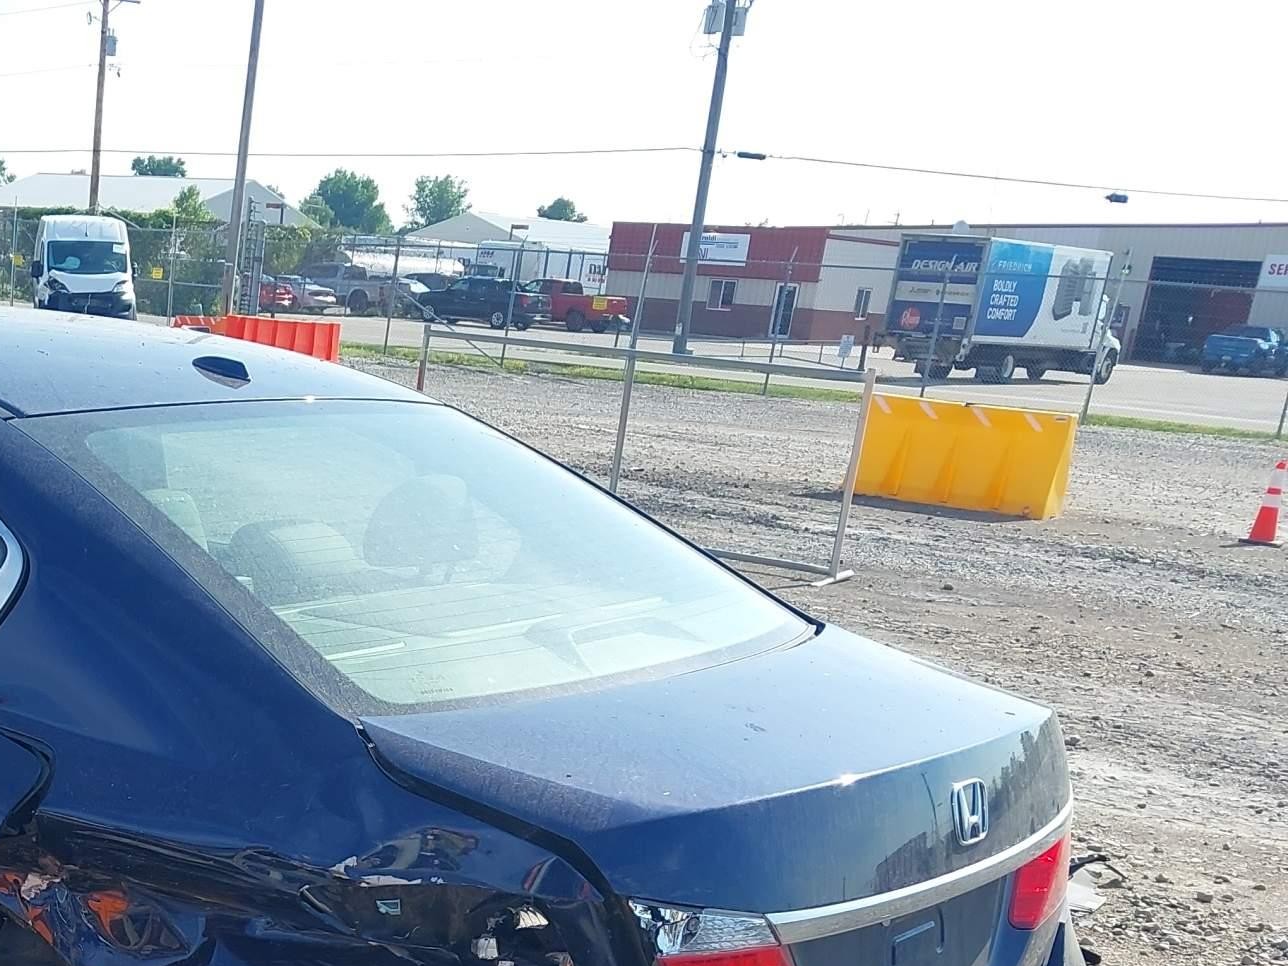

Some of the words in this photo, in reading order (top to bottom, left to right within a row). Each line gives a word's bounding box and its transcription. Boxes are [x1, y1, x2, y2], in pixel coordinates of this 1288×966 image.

[912, 259, 953, 272] DESIGN
[956, 261, 978, 272] AIR
[998, 260, 1033, 272] FRIEDRICH
[993, 280, 1018, 292] BOLDLY
[990, 294, 1019, 307] CRAFTED
[987, 308, 1017, 321] COMFORT
